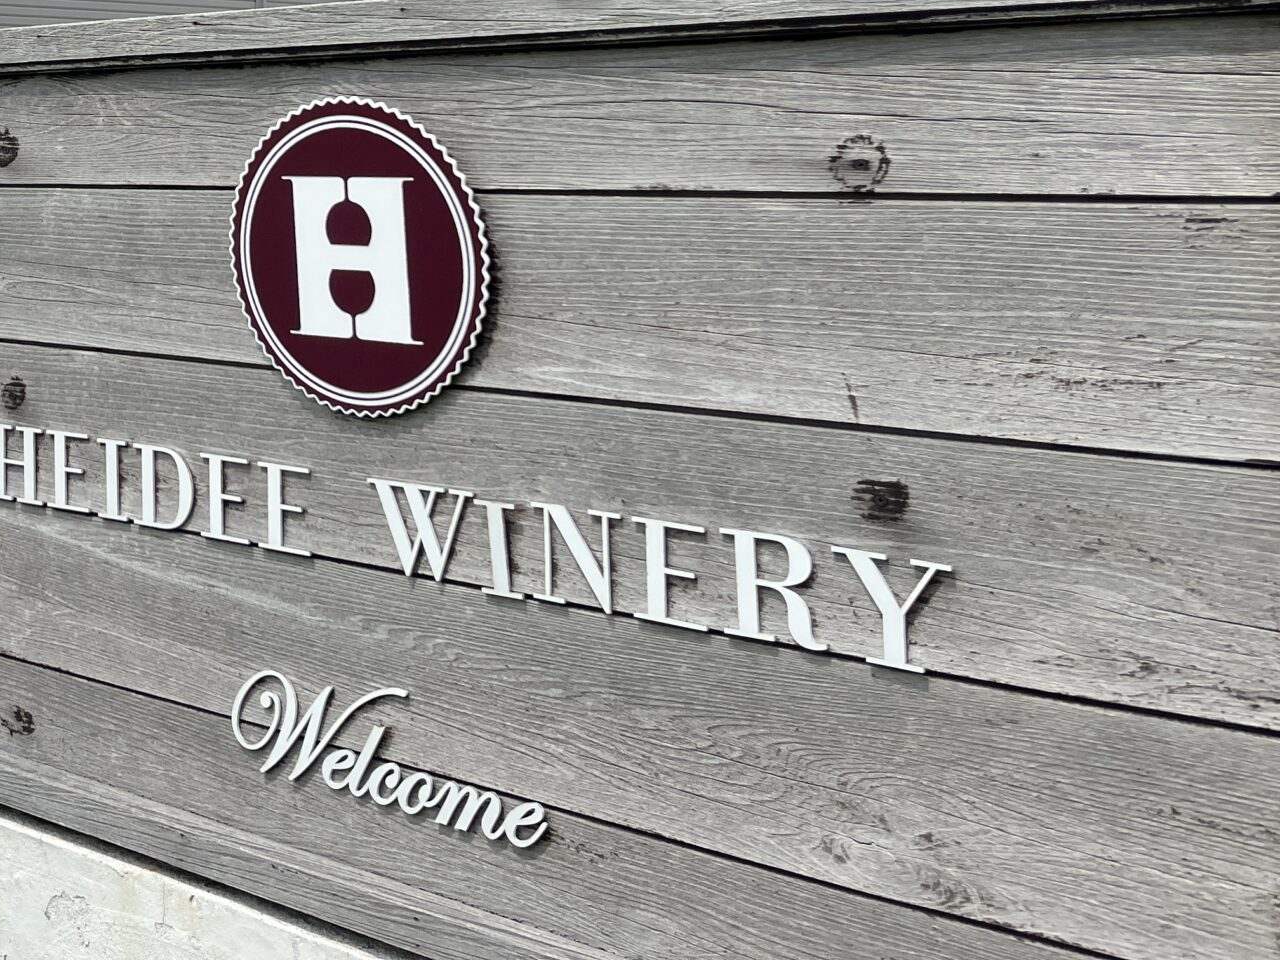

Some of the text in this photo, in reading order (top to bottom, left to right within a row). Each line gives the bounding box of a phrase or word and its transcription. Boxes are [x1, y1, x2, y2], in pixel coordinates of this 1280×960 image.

[281, 175, 423, 346] H
[366, 476, 951, 674] WINERY
[229, 668, 548, 849] Welcome
